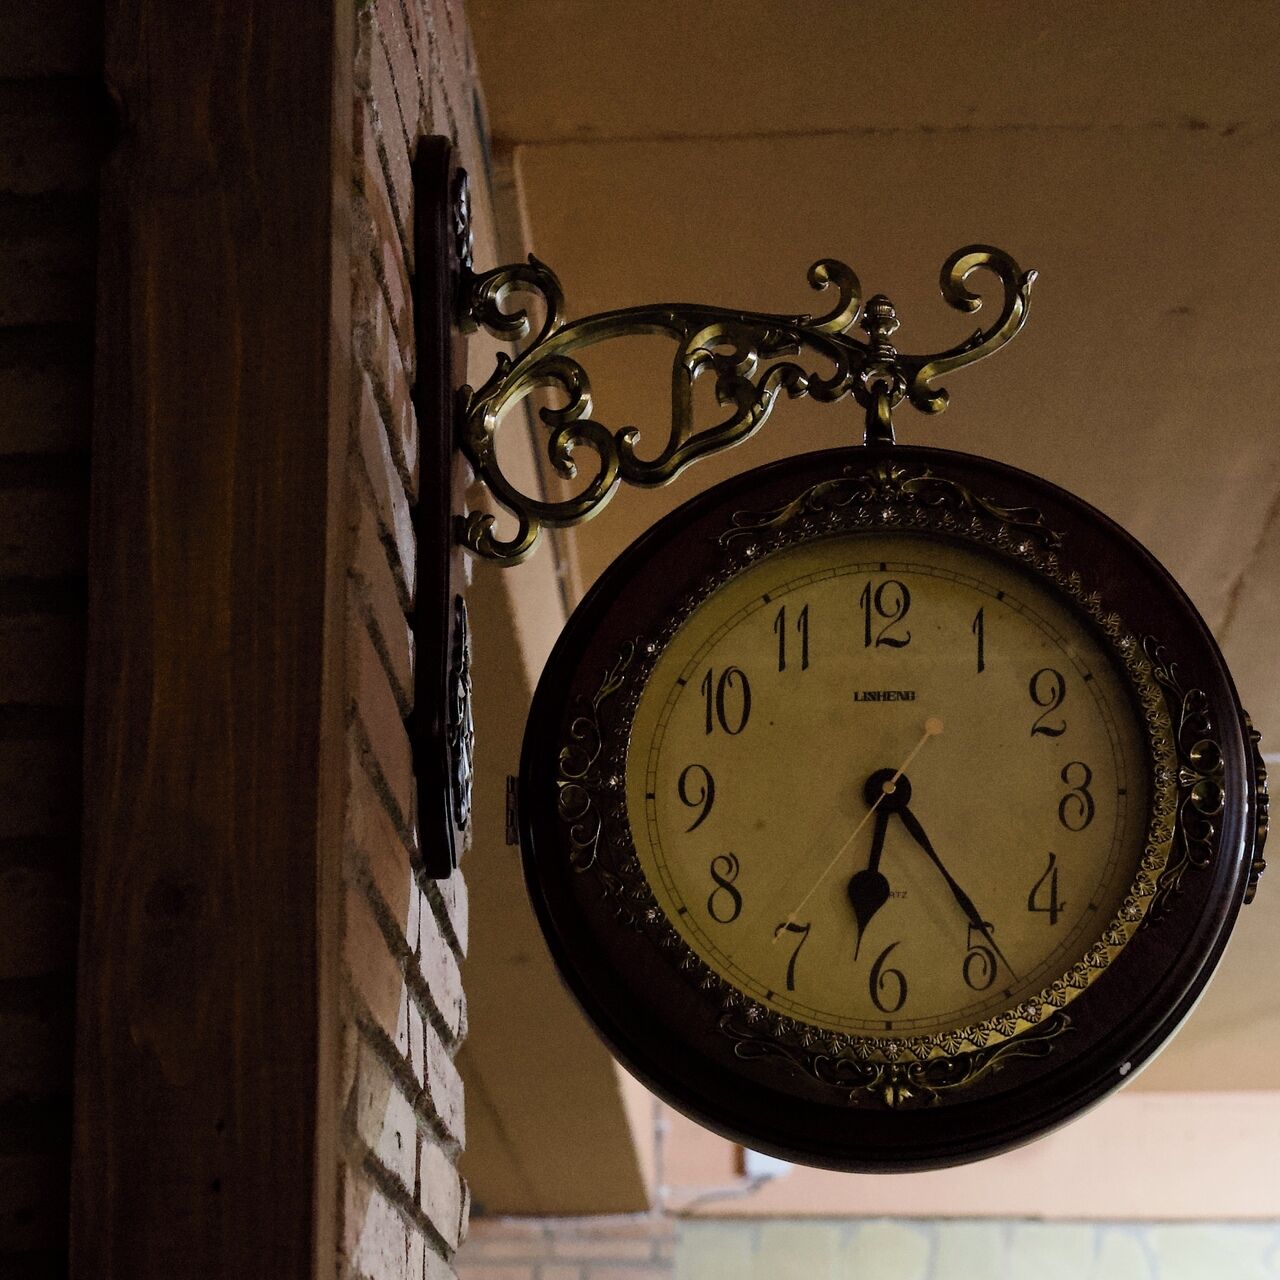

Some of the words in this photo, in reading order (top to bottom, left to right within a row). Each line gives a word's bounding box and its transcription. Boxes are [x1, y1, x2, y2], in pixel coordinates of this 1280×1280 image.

[774, 604, 809, 672] 11
[860, 580, 911, 648] 12
[972, 605, 984, 673] 1
[701, 666, 751, 735] 10
[1029, 668, 1066, 737] 2
[678, 764, 715, 832] 9
[1059, 762, 1095, 831] 3
[707, 853, 742, 924] 8
[1028, 852, 1066, 926] 4
[775, 923, 810, 991] 7
[869, 942, 907, 1013] 6
[963, 921, 997, 991] 5
